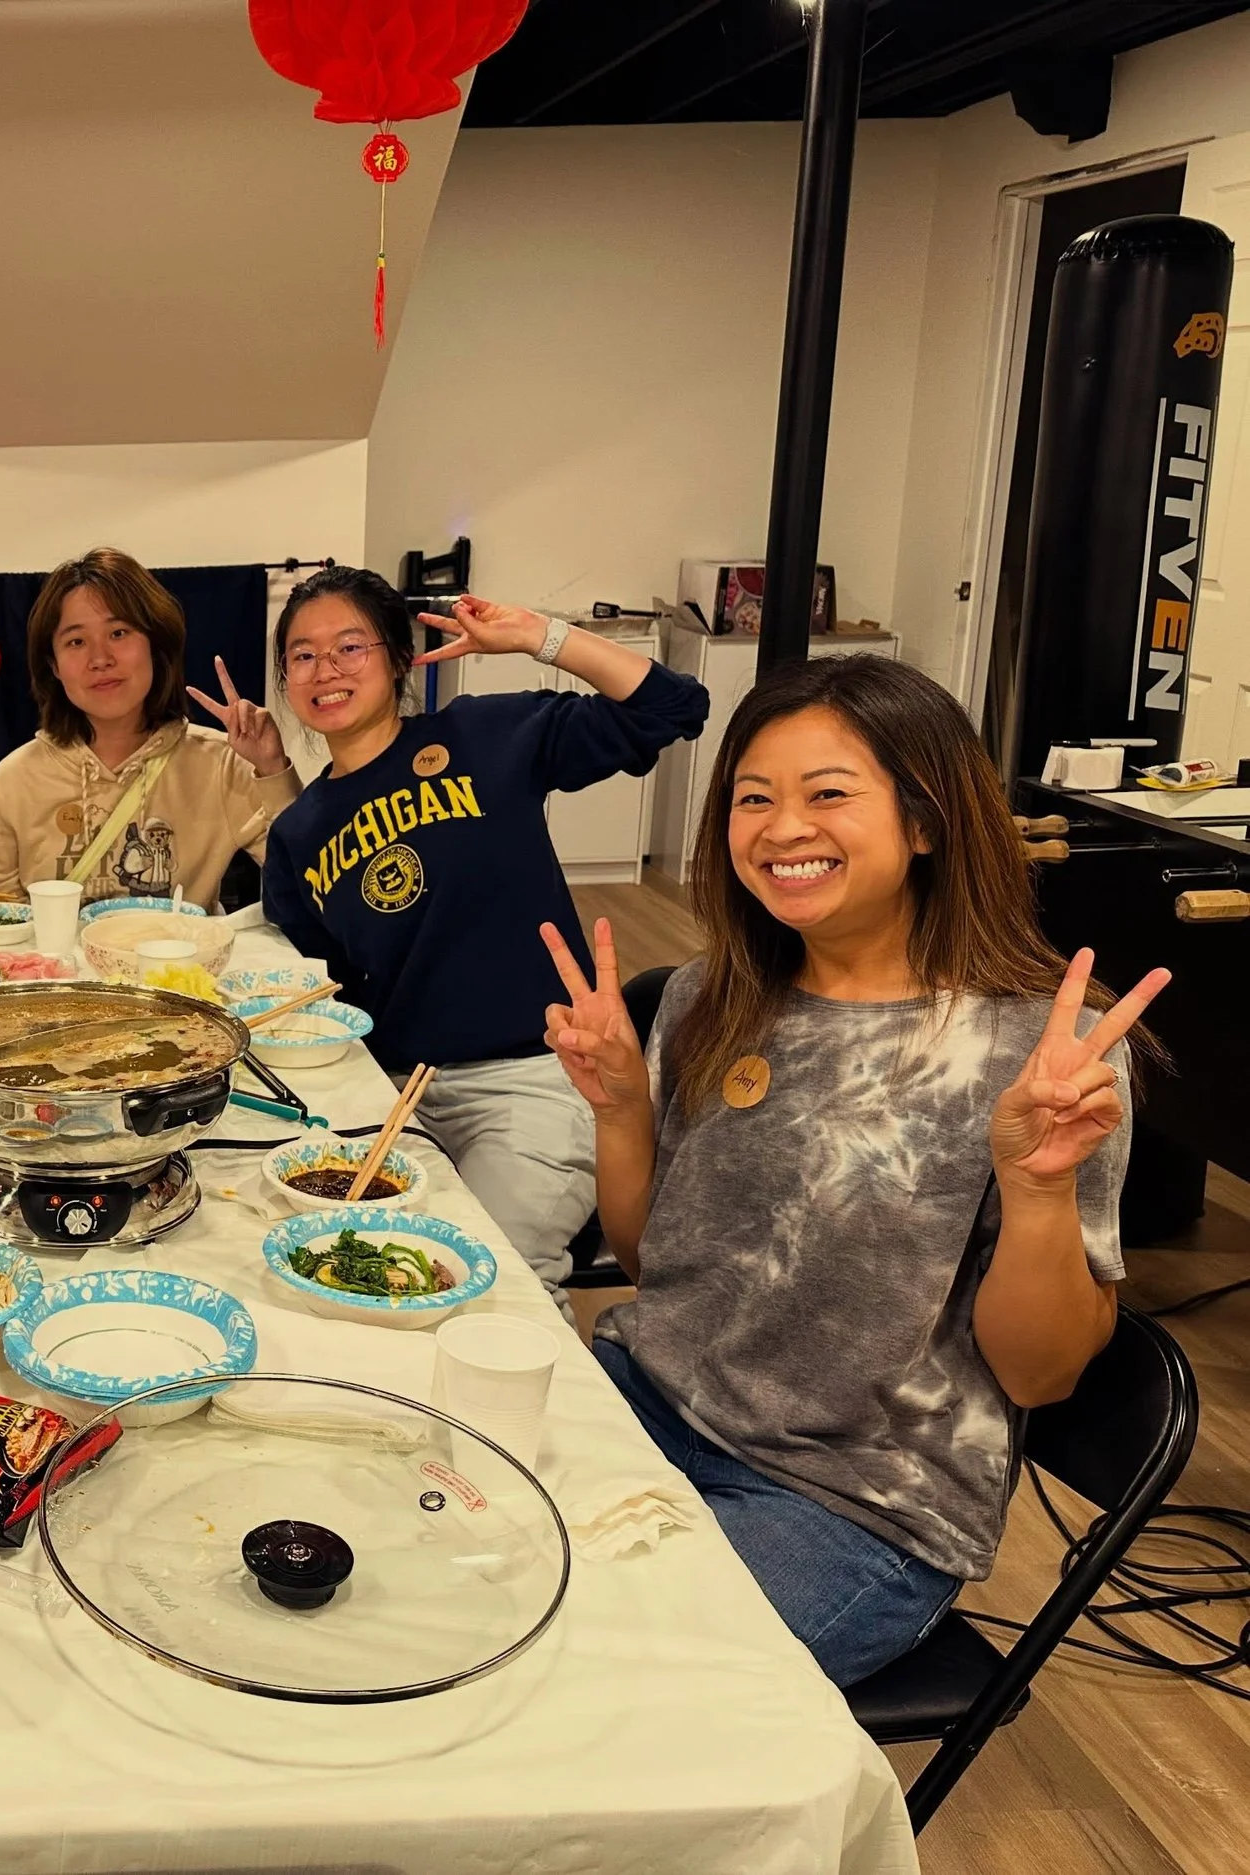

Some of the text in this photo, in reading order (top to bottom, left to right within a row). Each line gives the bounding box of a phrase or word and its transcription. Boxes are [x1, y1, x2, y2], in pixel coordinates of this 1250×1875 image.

[372, 145, 397, 171] 福
[1145, 403, 1211, 712] FITVEN
[418, 754, 440, 766] Angel
[304, 776, 483, 914] MICHIGAN
[732, 1068, 757, 1093] Amy
